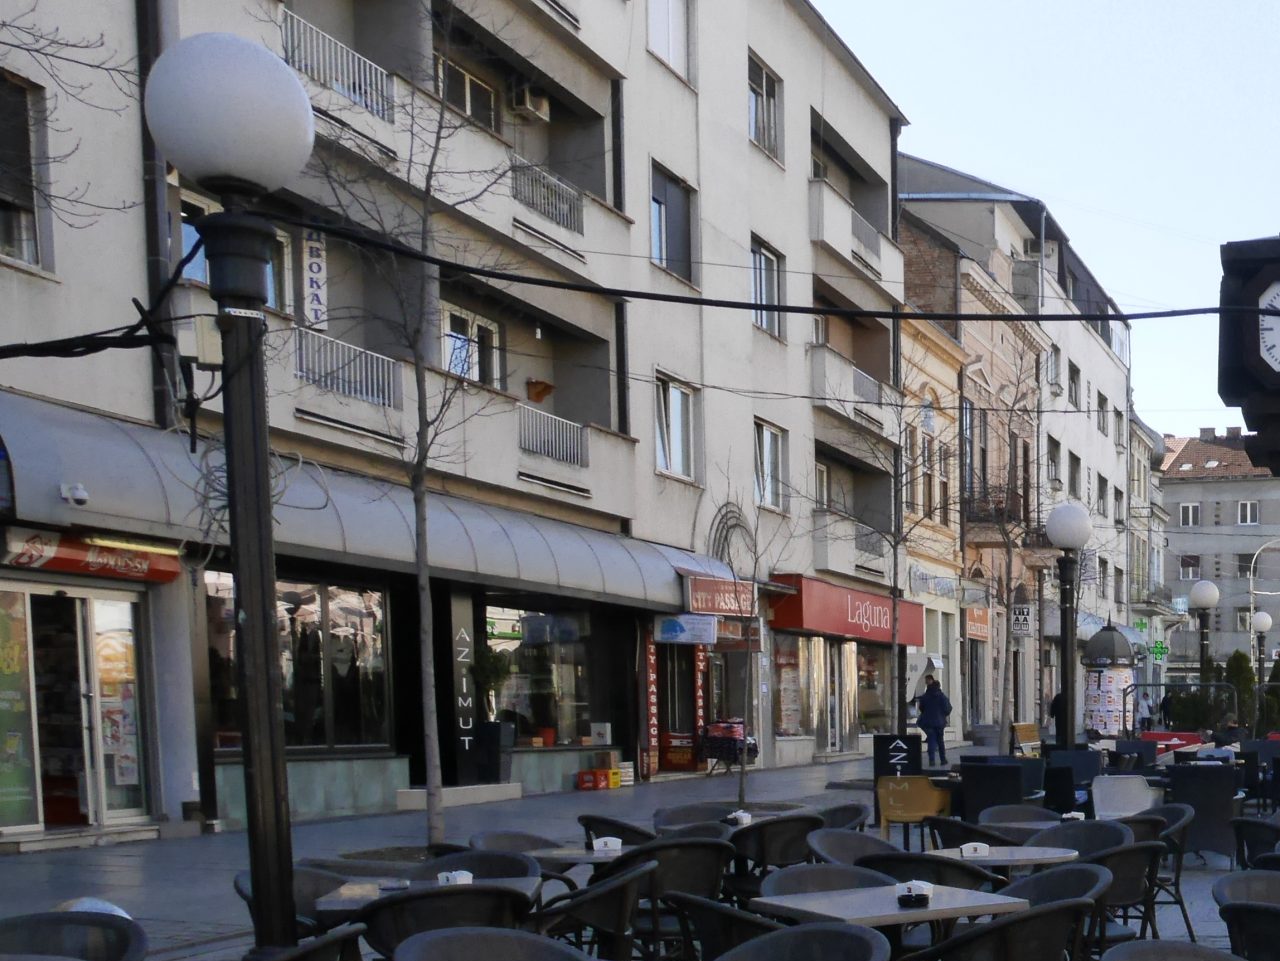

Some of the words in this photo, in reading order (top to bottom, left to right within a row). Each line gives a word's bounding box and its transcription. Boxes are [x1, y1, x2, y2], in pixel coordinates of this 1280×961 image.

[715, 591, 752, 611] PASSAGE
[848, 595, 890, 632] Laguna
[650, 673, 658, 745] PASSAGE
